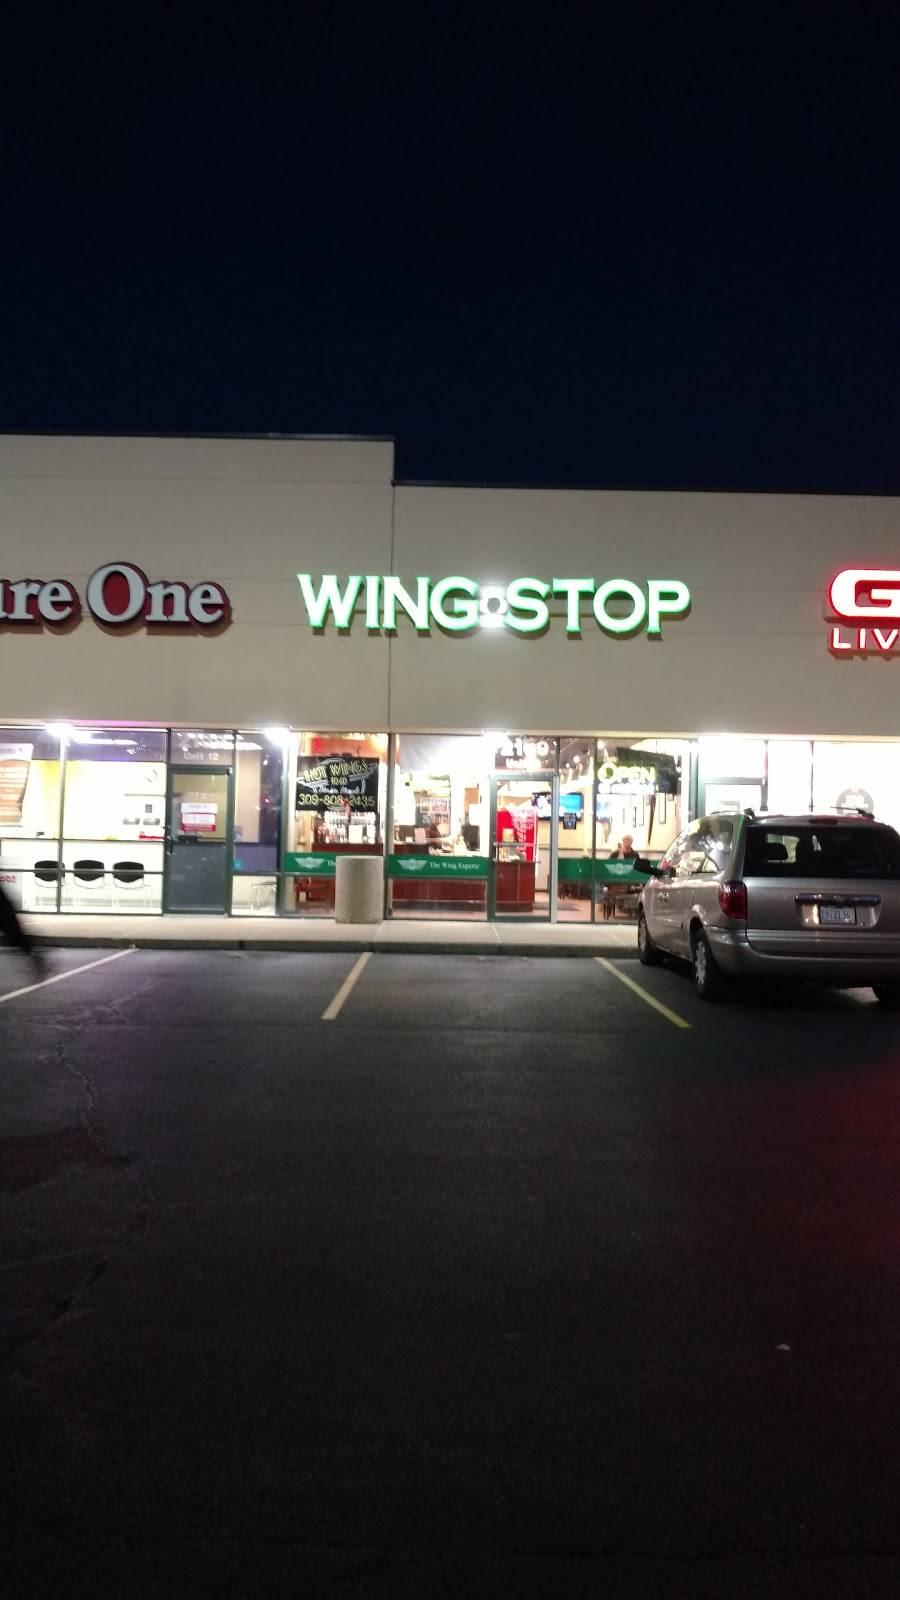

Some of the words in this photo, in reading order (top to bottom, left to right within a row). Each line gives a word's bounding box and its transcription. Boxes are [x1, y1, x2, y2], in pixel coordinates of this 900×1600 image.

[0, 582, 73, 621] re
[87, 563, 225, 624] One
[304, 766, 327, 782] HOT
[597, 761, 656, 784] OPEN
[429, 861, 441, 869] The
[442, 861, 457, 870] Wing
